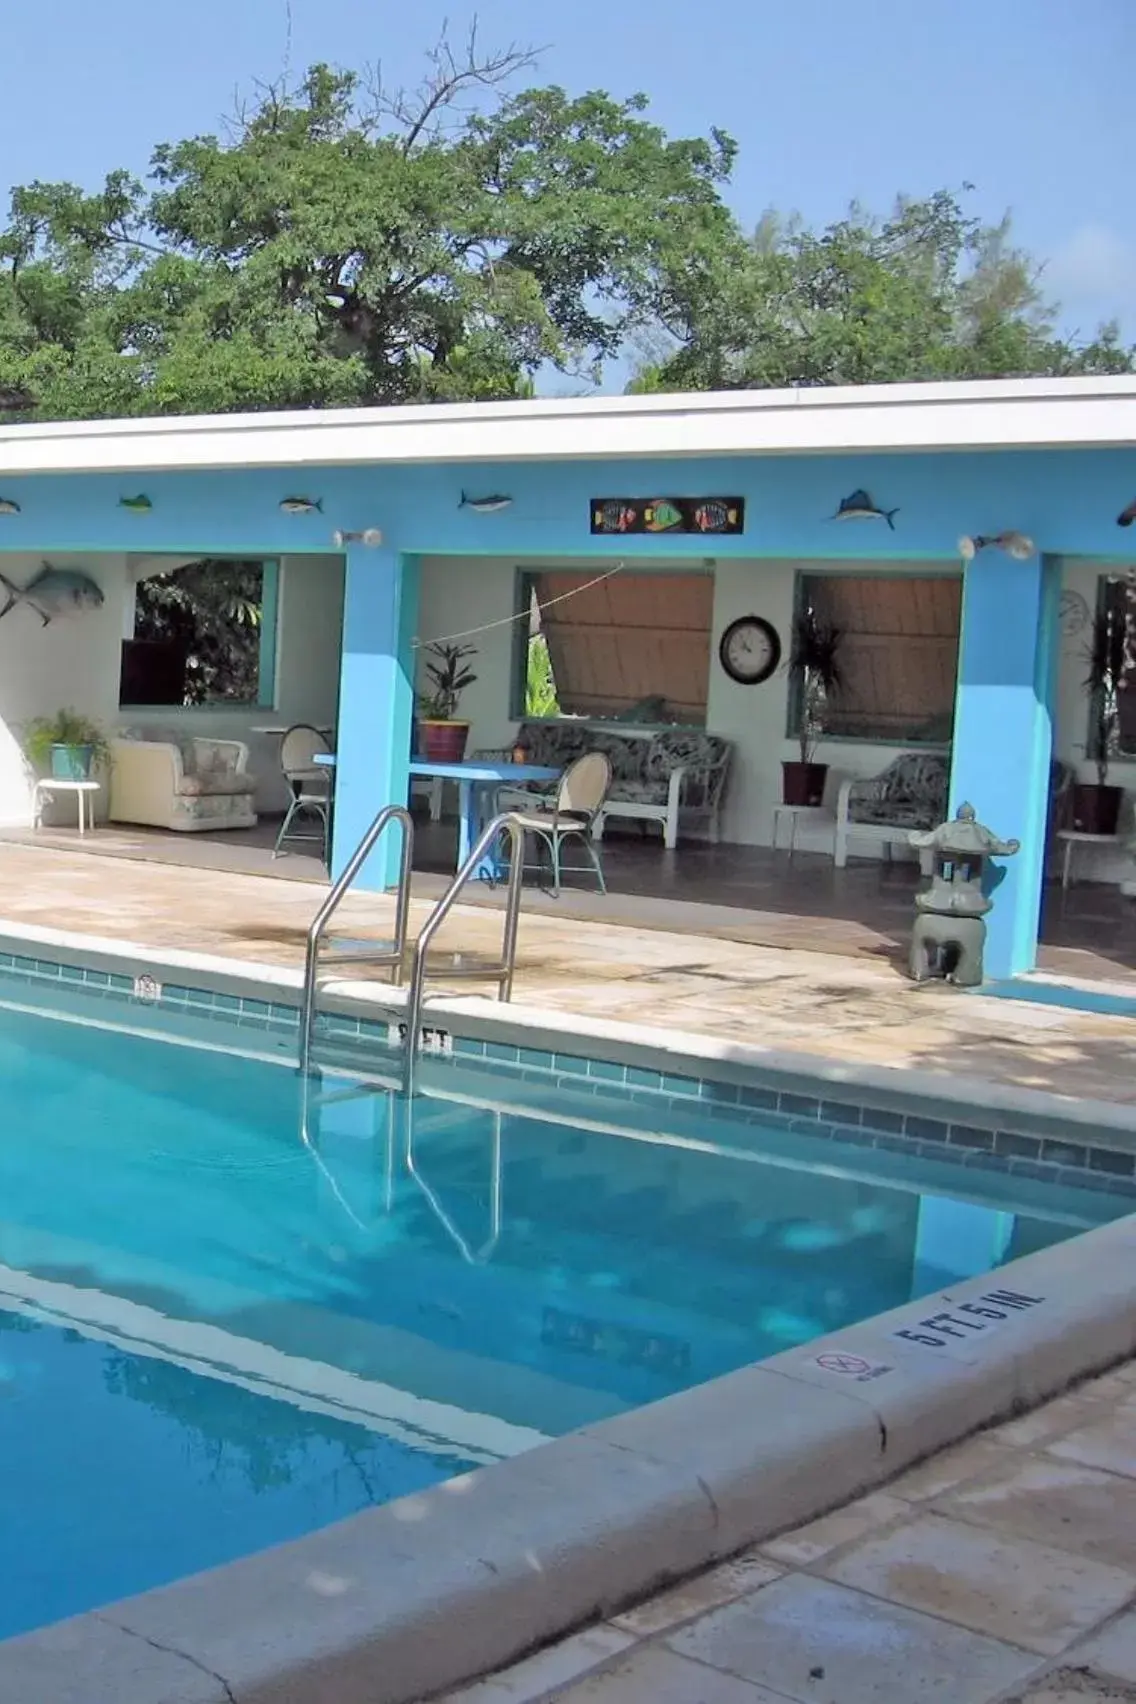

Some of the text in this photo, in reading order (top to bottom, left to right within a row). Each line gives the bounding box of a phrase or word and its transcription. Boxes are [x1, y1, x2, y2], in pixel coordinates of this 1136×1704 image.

[422, 1027, 448, 1048] FT
[893, 1330, 947, 1347] 5
[958, 1303, 1008, 1320] 5
